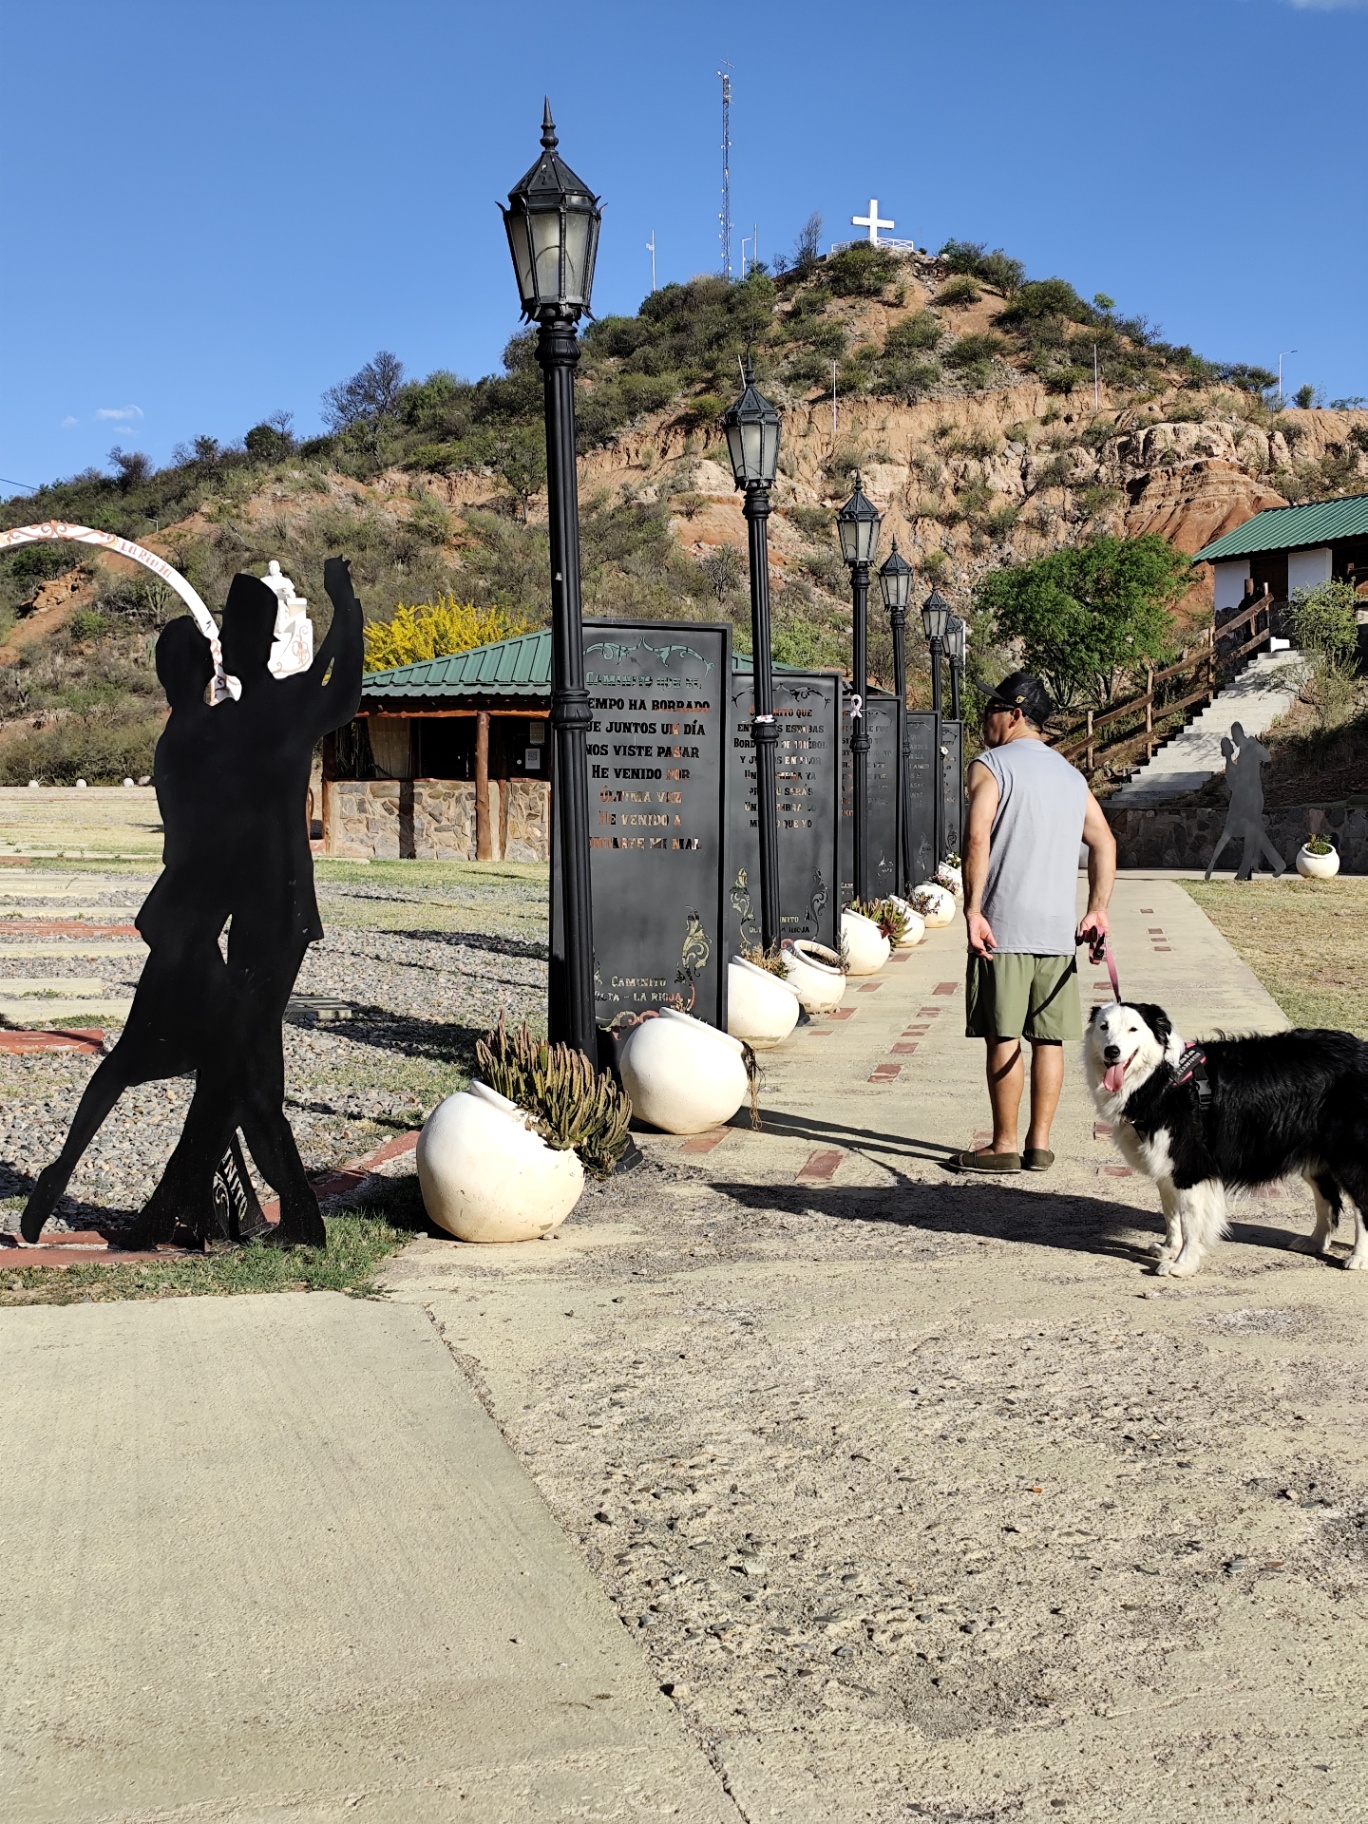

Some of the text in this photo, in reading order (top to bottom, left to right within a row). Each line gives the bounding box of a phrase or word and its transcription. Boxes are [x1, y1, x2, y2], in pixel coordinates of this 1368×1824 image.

[587, 698, 711, 713] EMPO HA BORRADO
[796, 708, 813, 718] QUE
[586, 719, 706, 735] UE JUNTOS UN DÍA
[586, 744, 699, 758] NOS VISTE PASAR
[785, 756, 797, 764] EN
[614, 768, 662, 779] VENIDO
[666, 768, 691, 780] POR
[621, 813, 669, 827] VENIDO
[633, 992, 647, 1001] LA
[651, 992, 682, 1001] RIOJA
